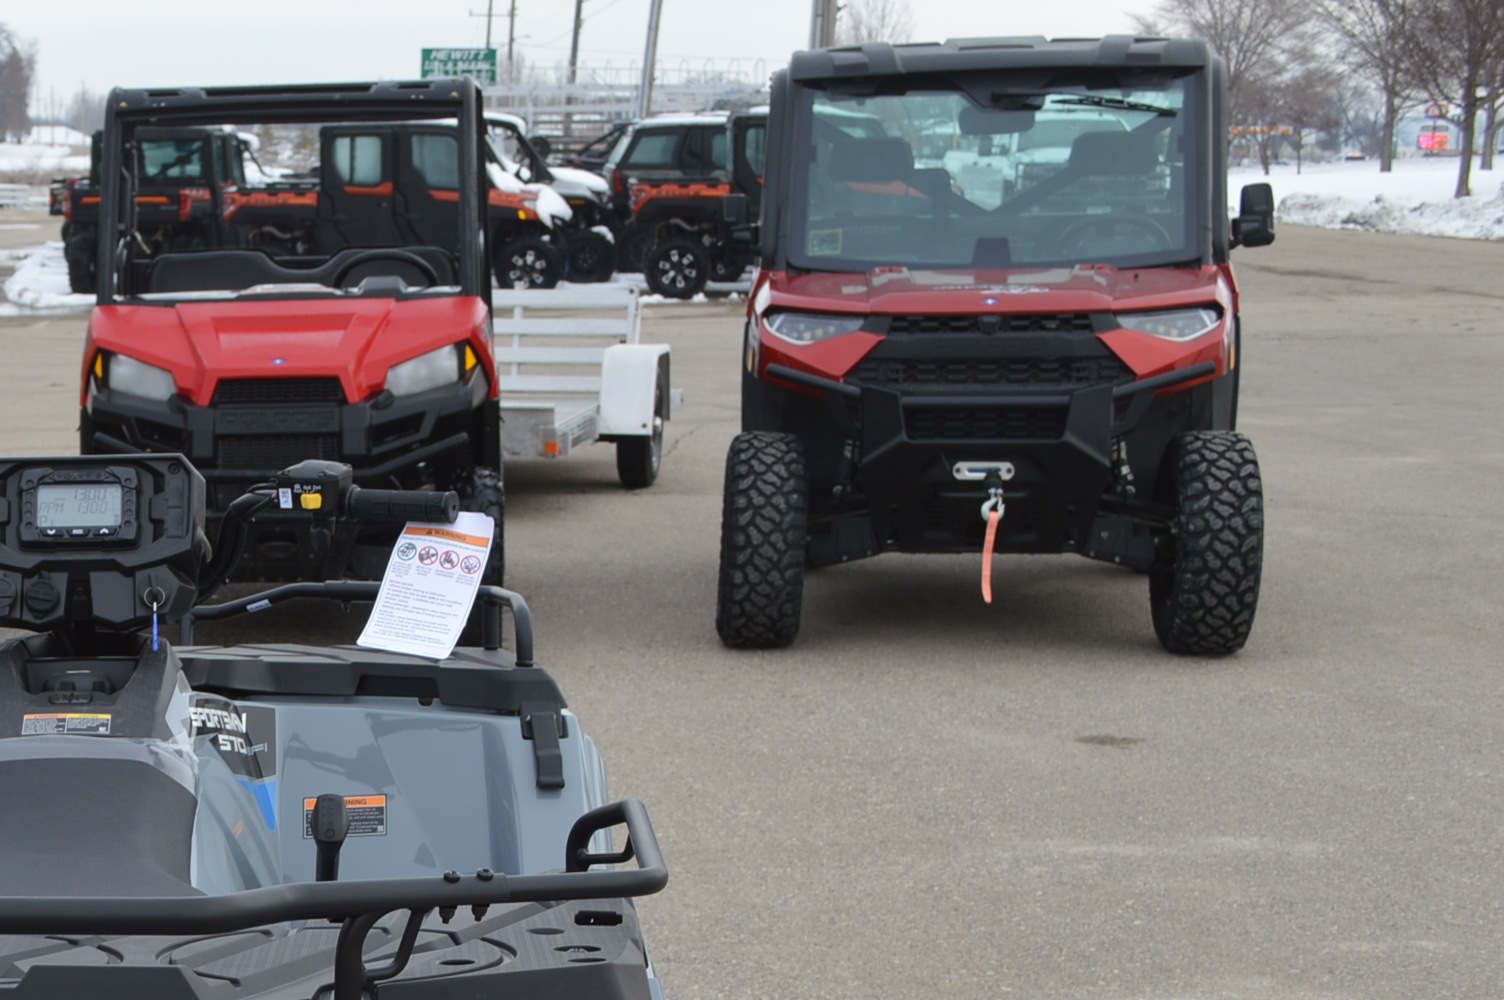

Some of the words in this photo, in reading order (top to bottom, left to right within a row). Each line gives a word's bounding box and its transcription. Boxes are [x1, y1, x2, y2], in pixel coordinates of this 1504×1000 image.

[430, 49, 488, 60] HEWITT
[434, 530, 466, 540] WARNING
[218, 734, 248, 754] 570
